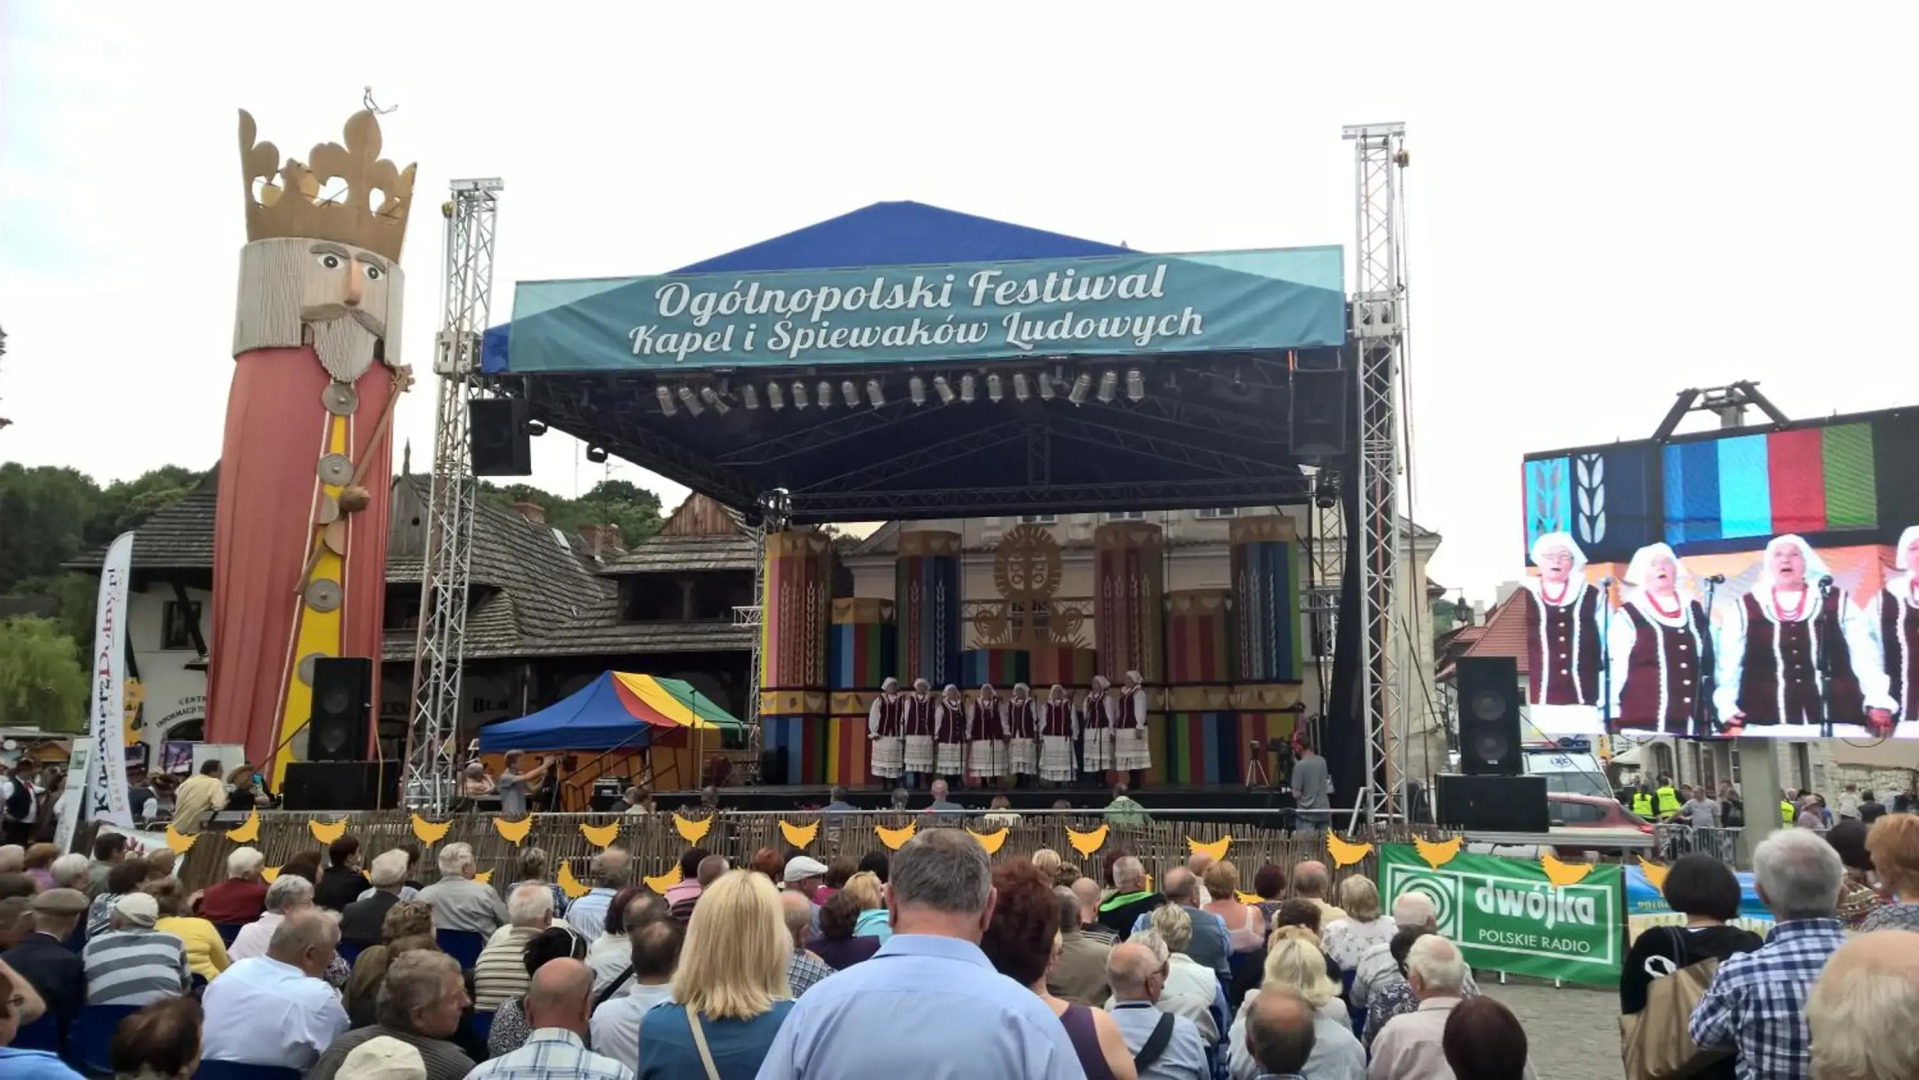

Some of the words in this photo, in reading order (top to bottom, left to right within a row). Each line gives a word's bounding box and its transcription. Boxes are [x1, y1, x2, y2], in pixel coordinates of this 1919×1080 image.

[653, 273, 955, 328] Ogólnopolski
[968, 264, 1168, 306] Festiwal
[628, 323, 735, 362] Kapel
[744, 323, 758, 351] i
[767, 311, 989, 360] Śpiewaków
[1002, 306, 1203, 350] Ludowych
[1475, 878, 1596, 930] dwójka
[1478, 929, 1538, 948] POLSKIE
[1541, 934, 1591, 954] RADIO
